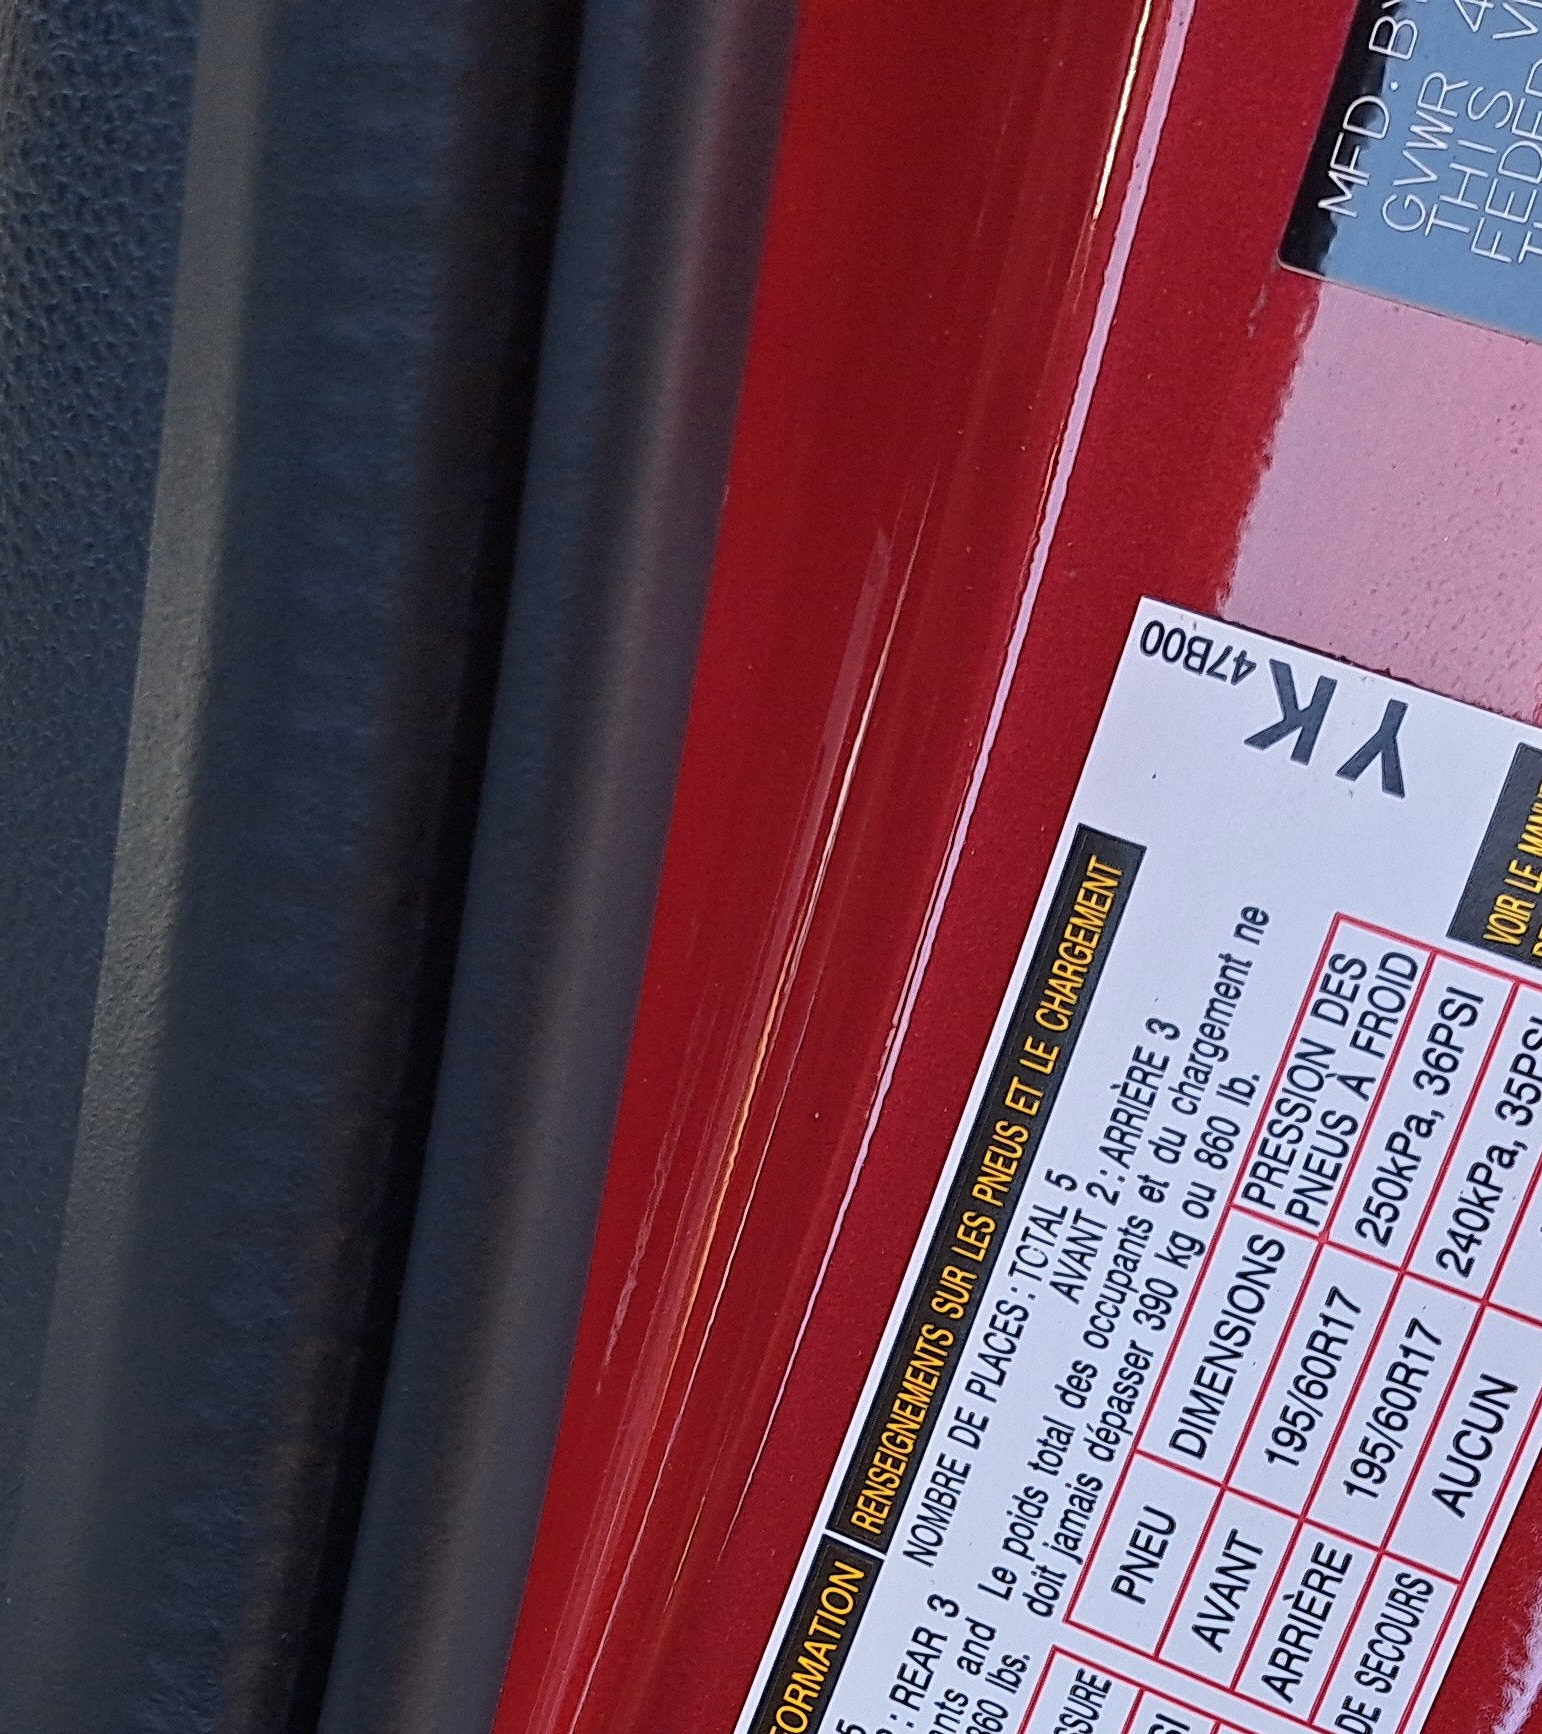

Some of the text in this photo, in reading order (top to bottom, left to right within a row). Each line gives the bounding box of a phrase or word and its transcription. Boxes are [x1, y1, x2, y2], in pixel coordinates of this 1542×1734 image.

[1382, 72, 1469, 231] GVWR
[1424, 86, 1514, 236] THIS
[1139, 620, 1257, 686] 47B00
[1486, 894, 1534, 945] VOIR
[1048, 1017, 1181, 1305] AVANT ARRIÈRE 3
[1240, 953, 1367, 1210] PRESSION DES
[1284, 951, 1419, 1228] PNEUS À FROID
[1354, 986, 1485, 1248] 250kPa, 36PSI
[850, 856, 1121, 1534] RENSEIGNEMENTS SUR LES PNEUS ET LE CHARGEMENT
[977, 906, 1270, 1601] Le poids total des occupants et du chargement ne
[1435, 1140, 1528, 1279] 240kPa,
[1021, 1074, 1260, 1618] doit jamais dépasser 390 kg ou 860 lb.
[1168, 1234, 1286, 1461] DIMENSIONS
[1264, 1285, 1362, 1467] 195/60R17
[1343, 1317, 1442, 1499] 195/60R17
[902, 1405, 990, 1568] NOMBRE DE
[1431, 1372, 1519, 1519] AUCUN
[1110, 1504, 1177, 1605] PNEU
[1191, 1528, 1264, 1654] AVANT
[1260, 1541, 1353, 1704] ARRIÈRE
[1354, 1572, 1434, 1694] SECOURS
[888, 1626, 948, 1712] REAR
[926, 1593, 960, 1618] 3
[956, 1616, 997, 1676] and
[984, 1654, 1031, 1695] lbs.
